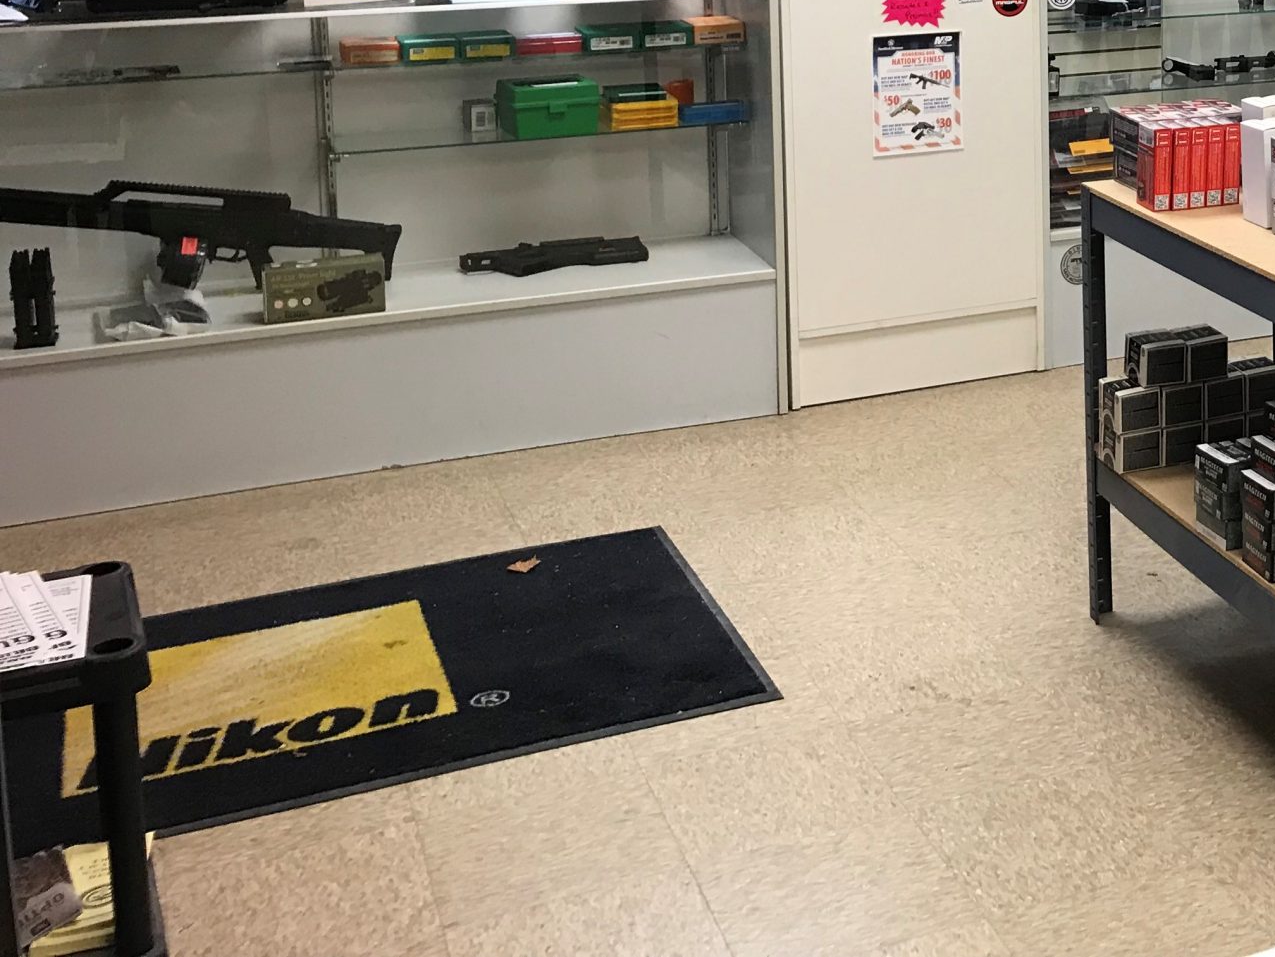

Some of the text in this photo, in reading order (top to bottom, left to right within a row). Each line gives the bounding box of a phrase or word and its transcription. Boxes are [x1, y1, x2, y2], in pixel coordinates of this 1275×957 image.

[891, 55, 945, 66] NATION'S FINEST
[929, 69, 951, 80] $100
[884, 95, 900, 106] $50
[936, 117, 952, 128] $30
[1200, 455, 1224, 474] MAGTECH
[1244, 482, 1267, 501] MAGTECH
